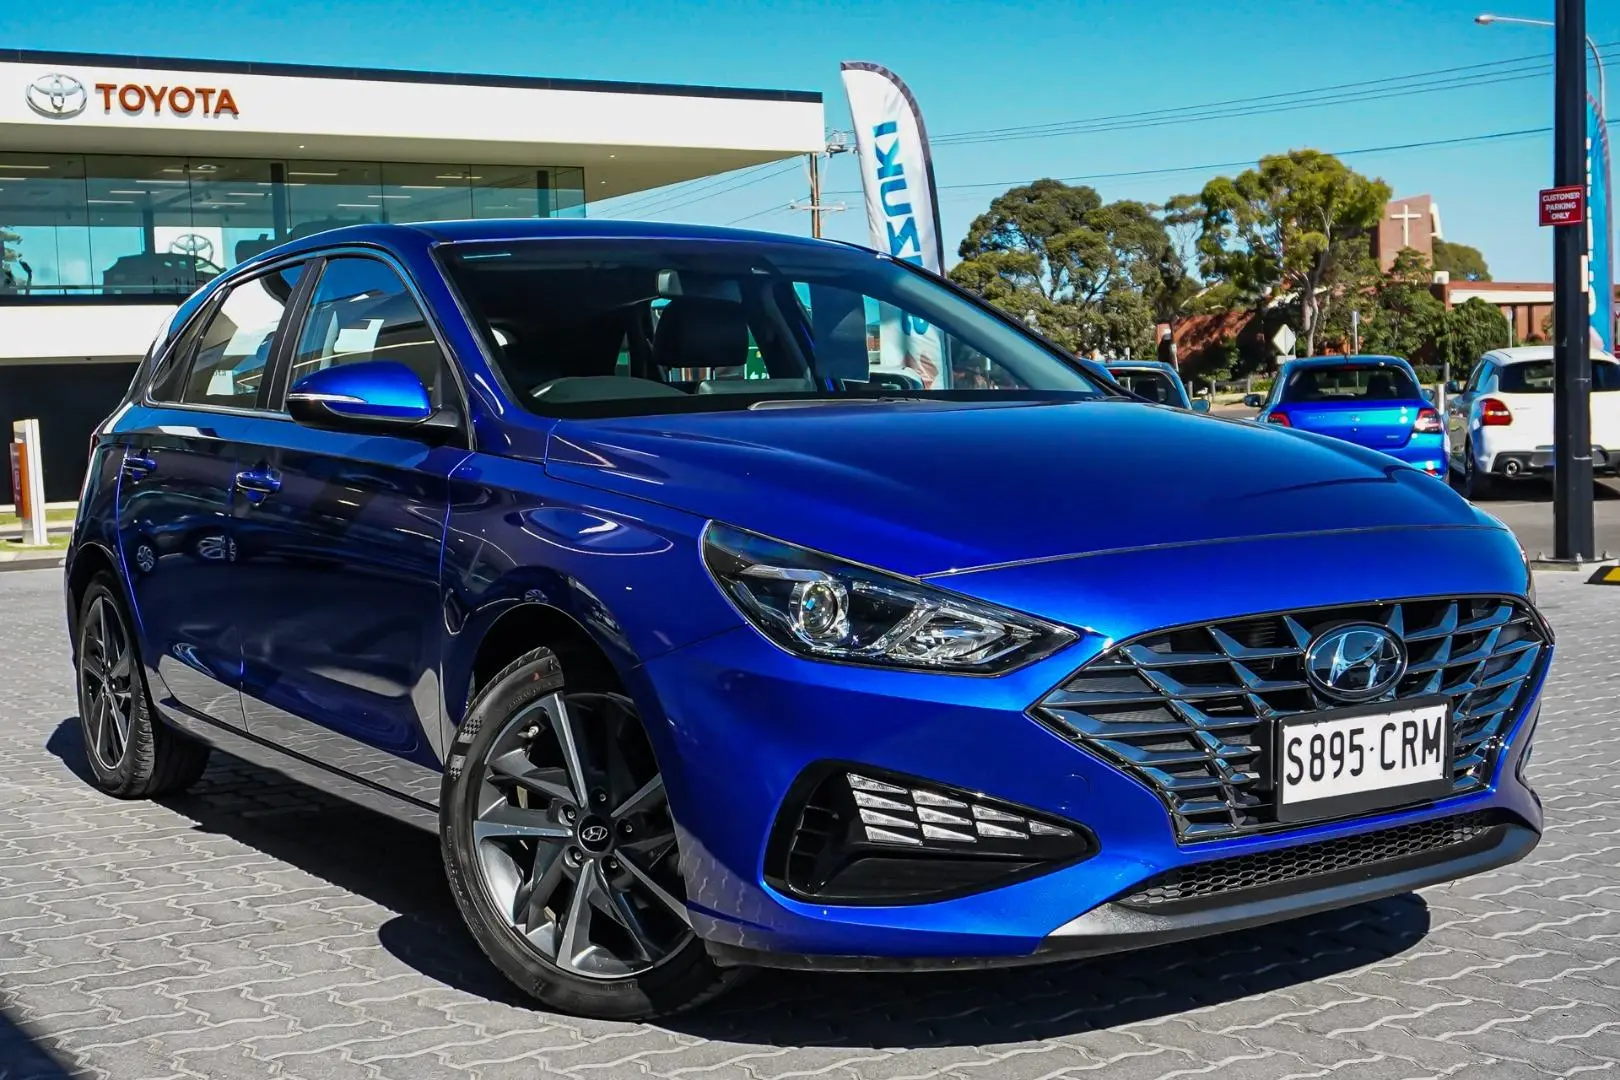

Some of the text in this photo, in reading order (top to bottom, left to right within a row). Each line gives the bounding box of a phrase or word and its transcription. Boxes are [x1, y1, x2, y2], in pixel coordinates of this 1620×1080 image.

[95, 83, 240, 115] TOYOTA
[1542, 192, 1580, 201] CUSTOMER
[1545, 202, 1576, 210] PARKING
